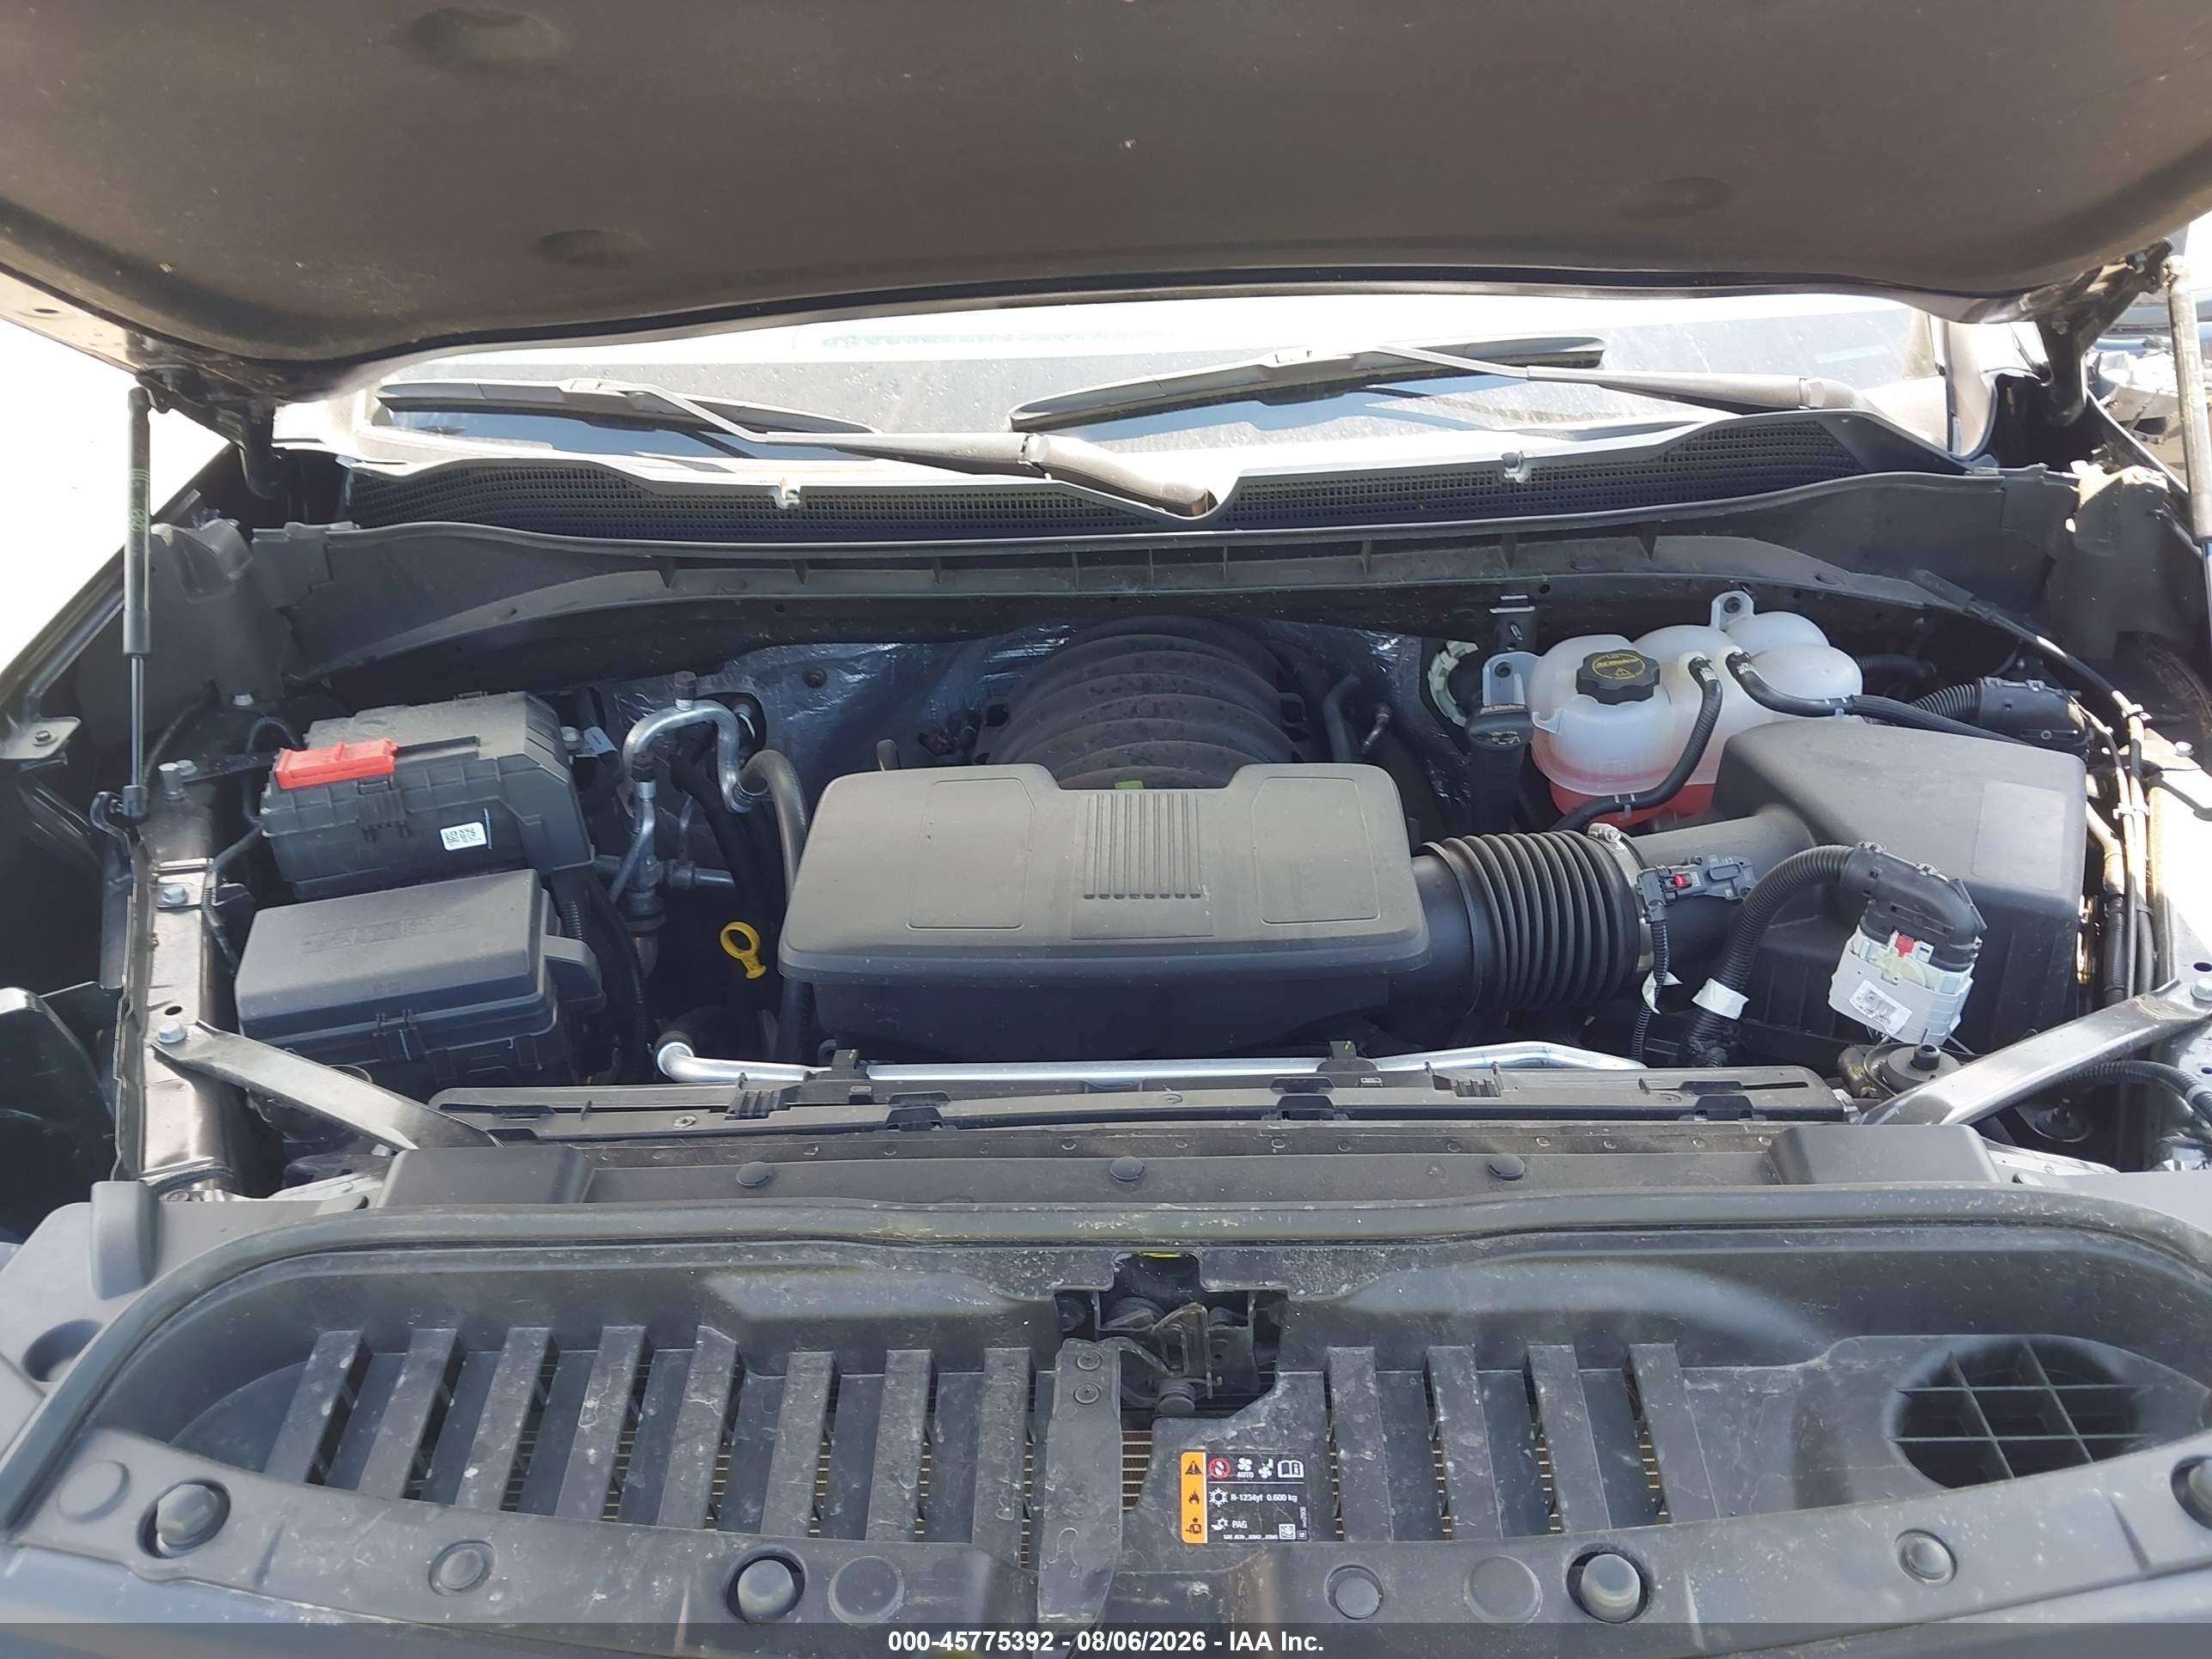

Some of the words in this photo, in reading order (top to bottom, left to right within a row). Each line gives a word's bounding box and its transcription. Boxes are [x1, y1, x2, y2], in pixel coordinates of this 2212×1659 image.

[1231, 1493, 1263, 1503] R-1234yf
[1287, 1493, 1297, 1503] kg
[1231, 1520, 1248, 1528] PAG
